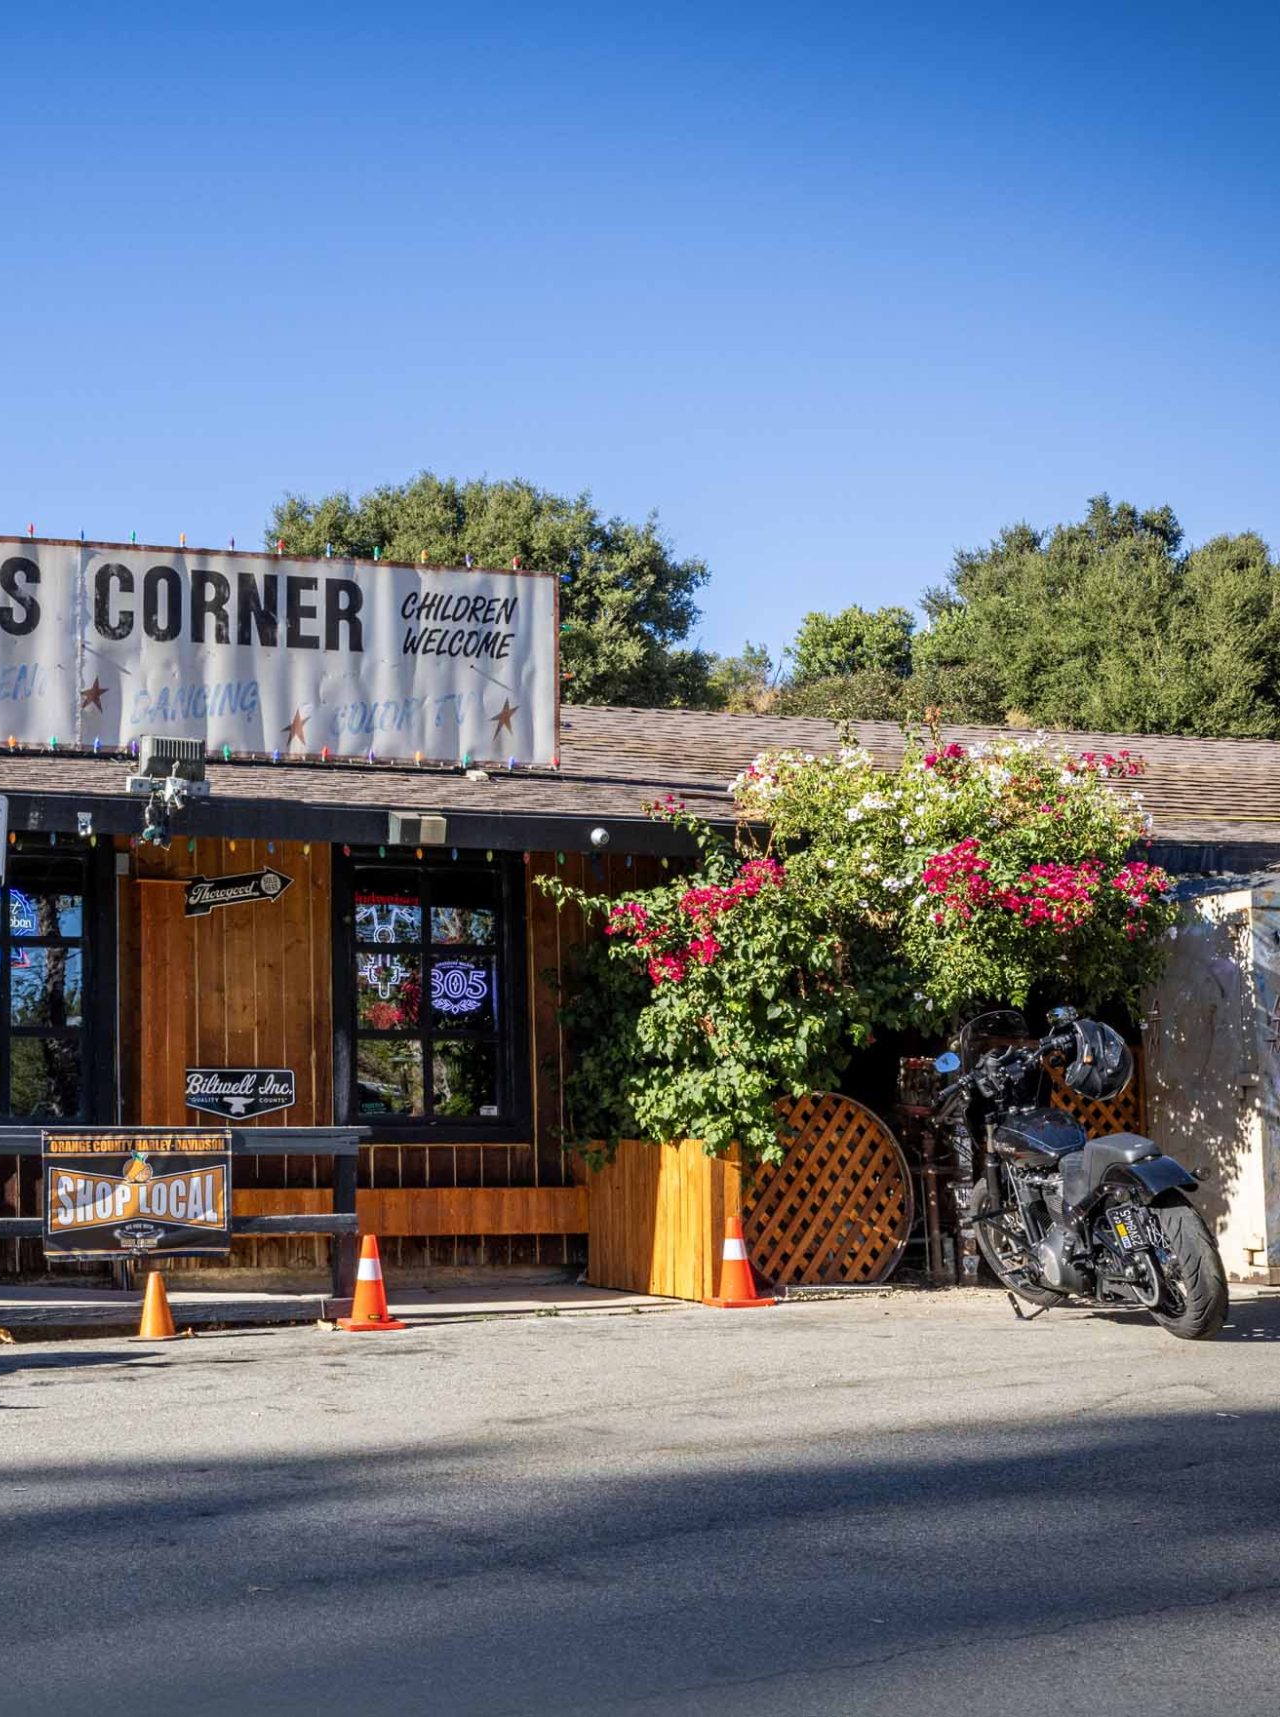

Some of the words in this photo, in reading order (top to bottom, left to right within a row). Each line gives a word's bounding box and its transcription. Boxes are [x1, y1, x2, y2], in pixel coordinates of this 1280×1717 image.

[93, 562, 364, 653] CORNER
[400, 591, 518, 625] CHILDREN
[401, 627, 516, 661] WELCOME
[130, 680, 260, 725] DANCING
[188, 880, 260, 905] Thorogood
[185, 1073, 257, 1094] Biltwell
[259, 1074, 293, 1095] Inc.
[50, 1140, 91, 1153] ORANGE
[93, 1139, 132, 1153] COUNTY
[135, 1139, 224, 1151] HARLEY-DAVIDSON
[57, 1175, 131, 1226] SHOP
[138, 1174, 218, 1223] LOCAL
